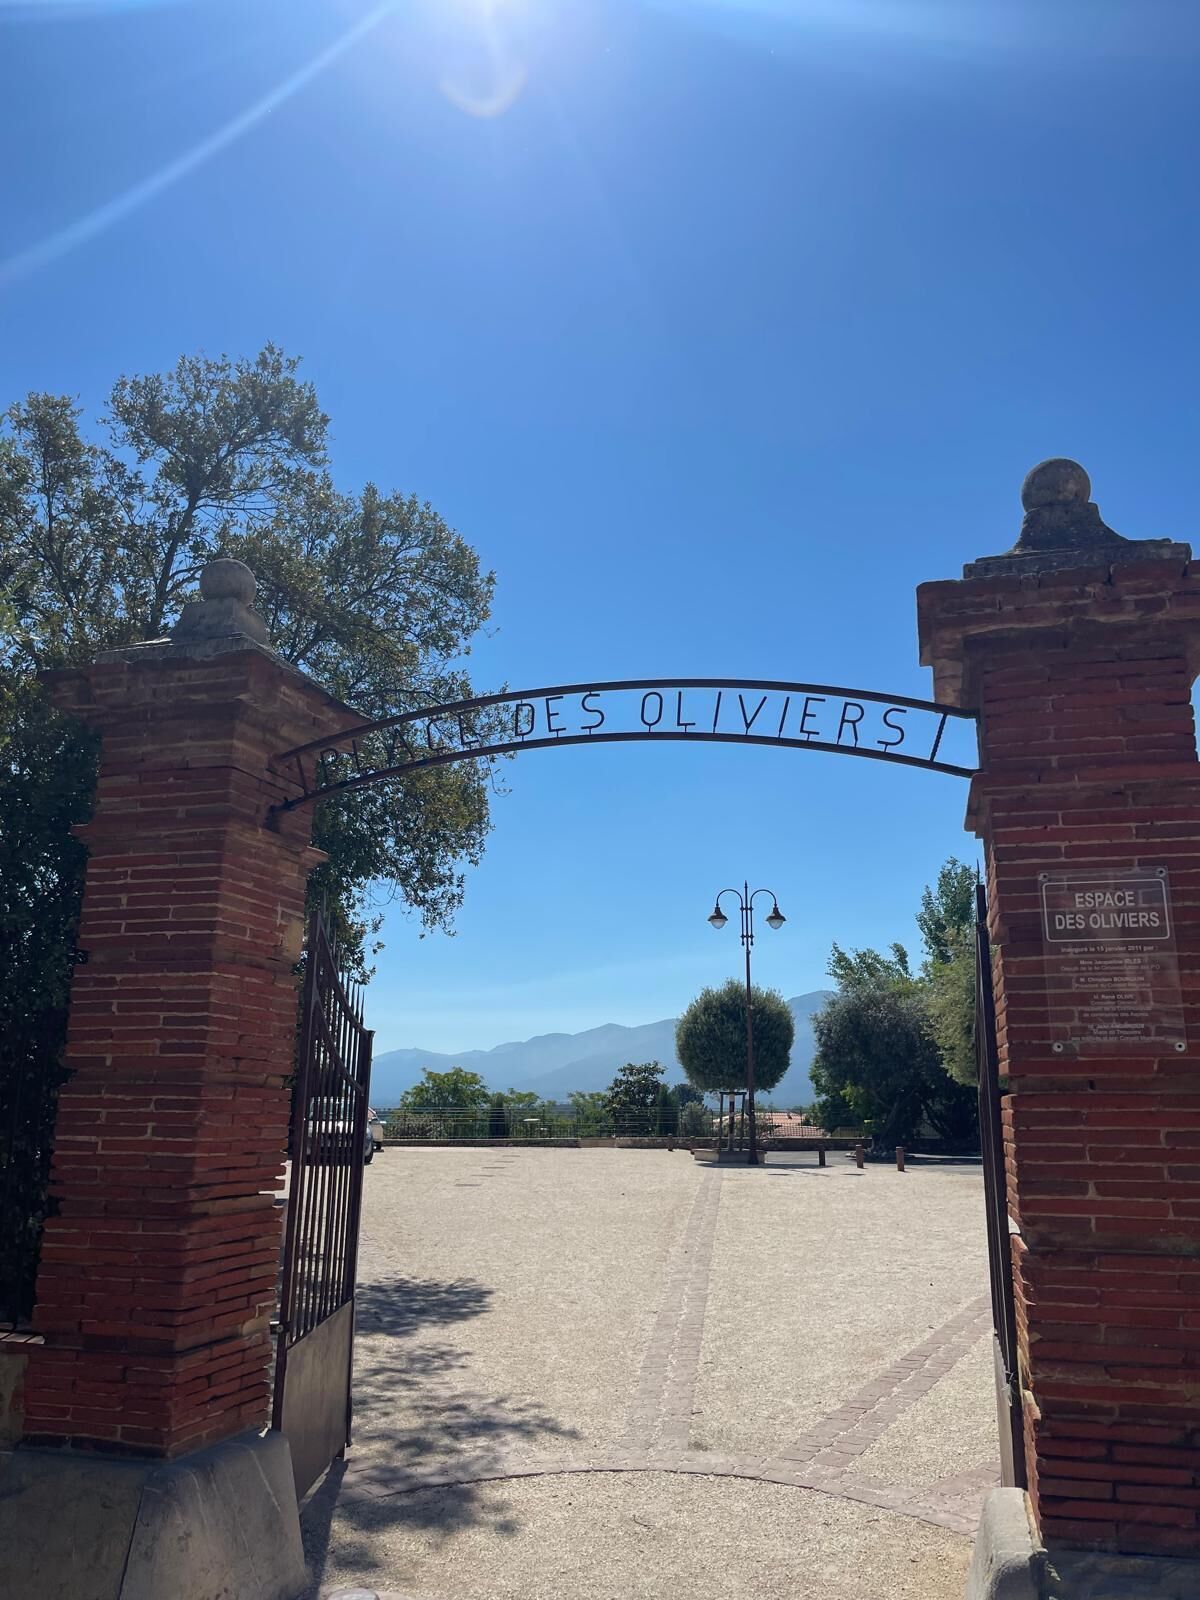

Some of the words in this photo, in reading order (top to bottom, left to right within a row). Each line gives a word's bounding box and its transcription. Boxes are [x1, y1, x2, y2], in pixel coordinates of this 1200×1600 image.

[514, 693, 605, 737] DES
[640, 690, 908, 748] OLIVIERS
[1074, 891, 1136, 908] ESPACE
[1055, 914, 1086, 930] DES
[1089, 912, 1160, 929] OLIVIERS
